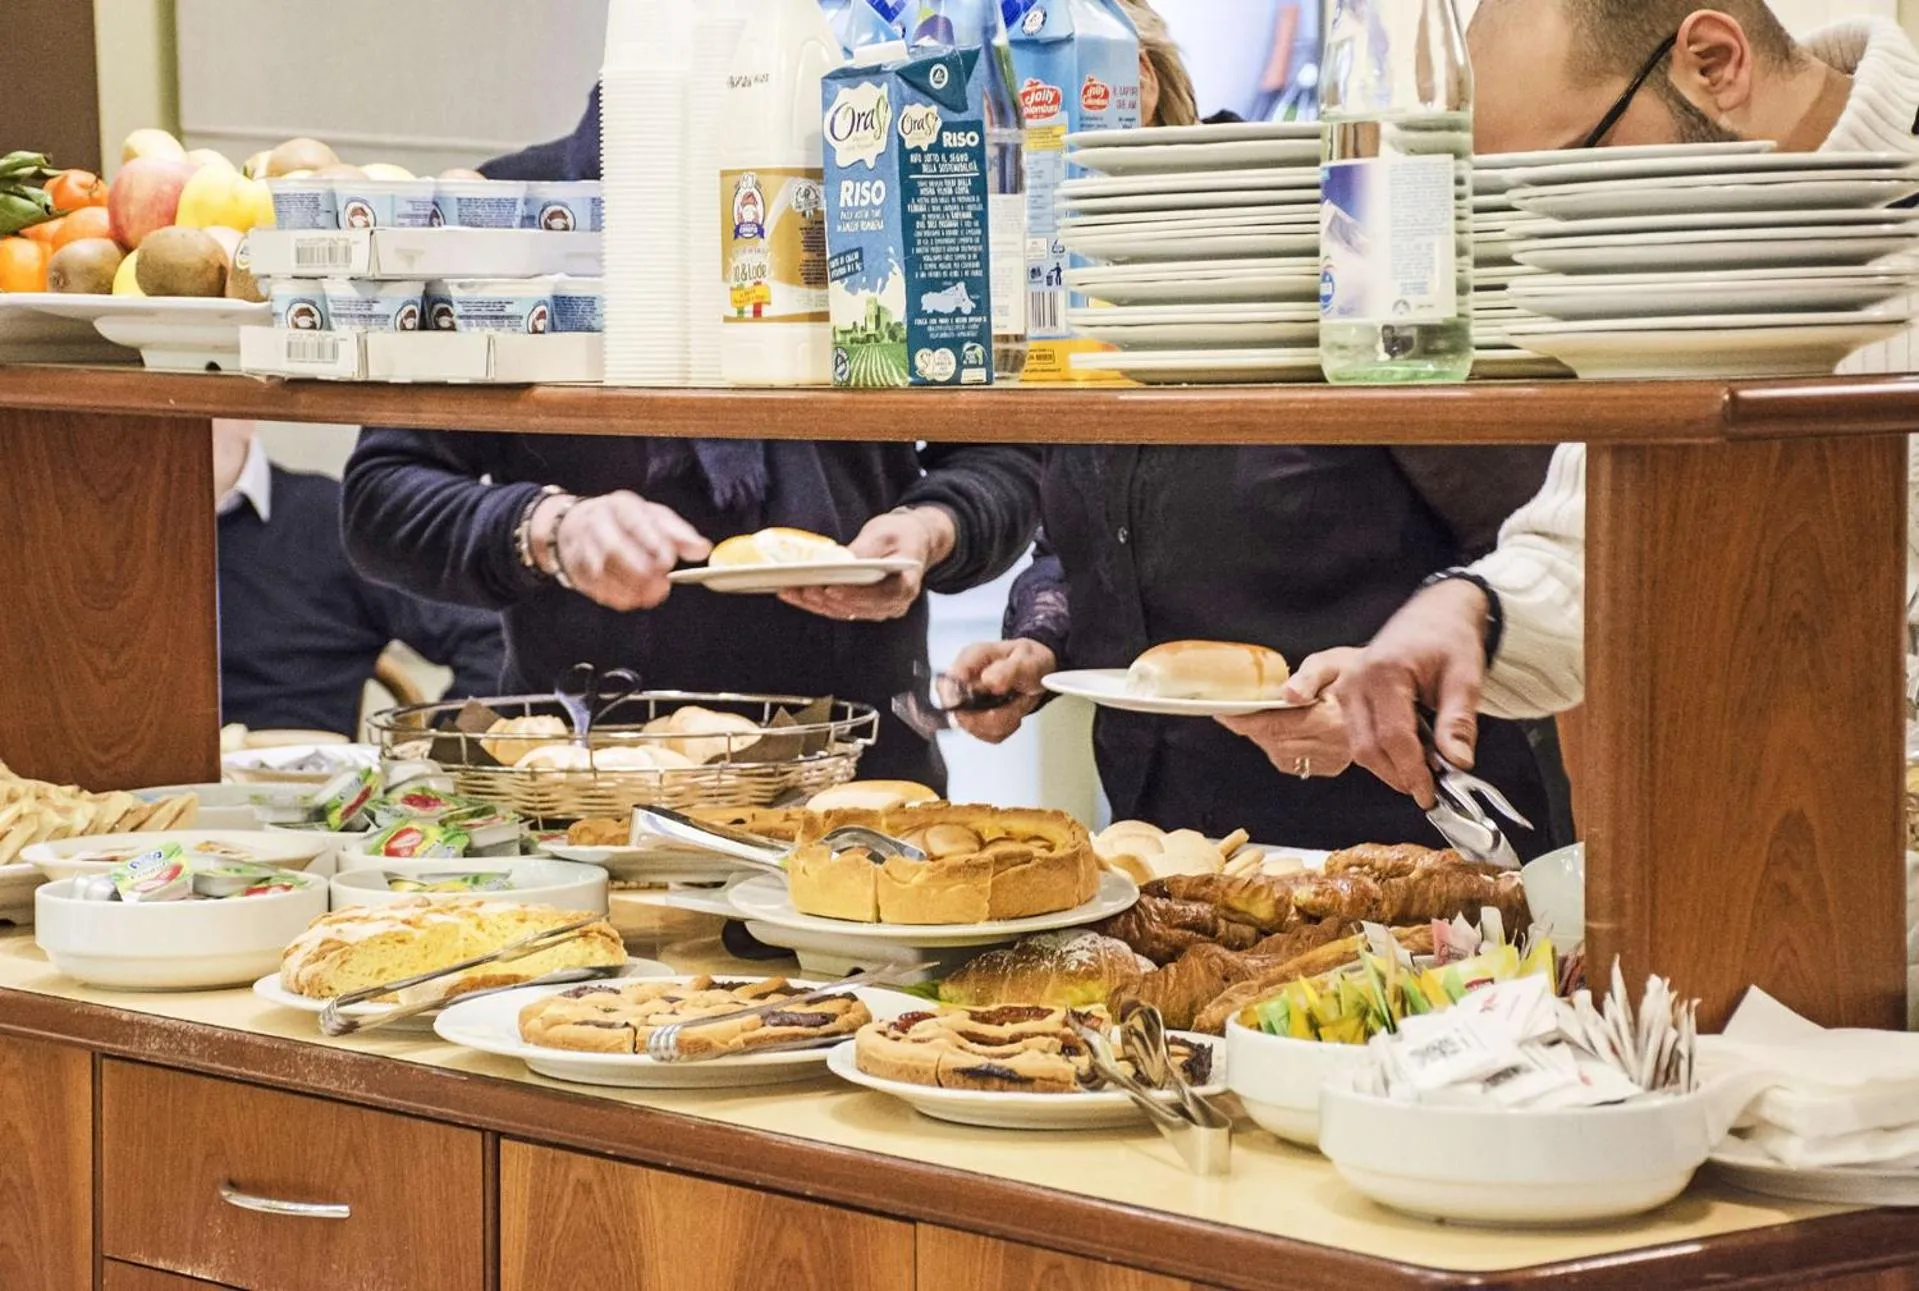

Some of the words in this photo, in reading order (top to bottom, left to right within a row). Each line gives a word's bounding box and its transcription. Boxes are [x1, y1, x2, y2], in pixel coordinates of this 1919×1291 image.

[1025, 88, 1057, 105] Jolly
[942, 131, 980, 147] RISO
[839, 179, 886, 208] RISO
